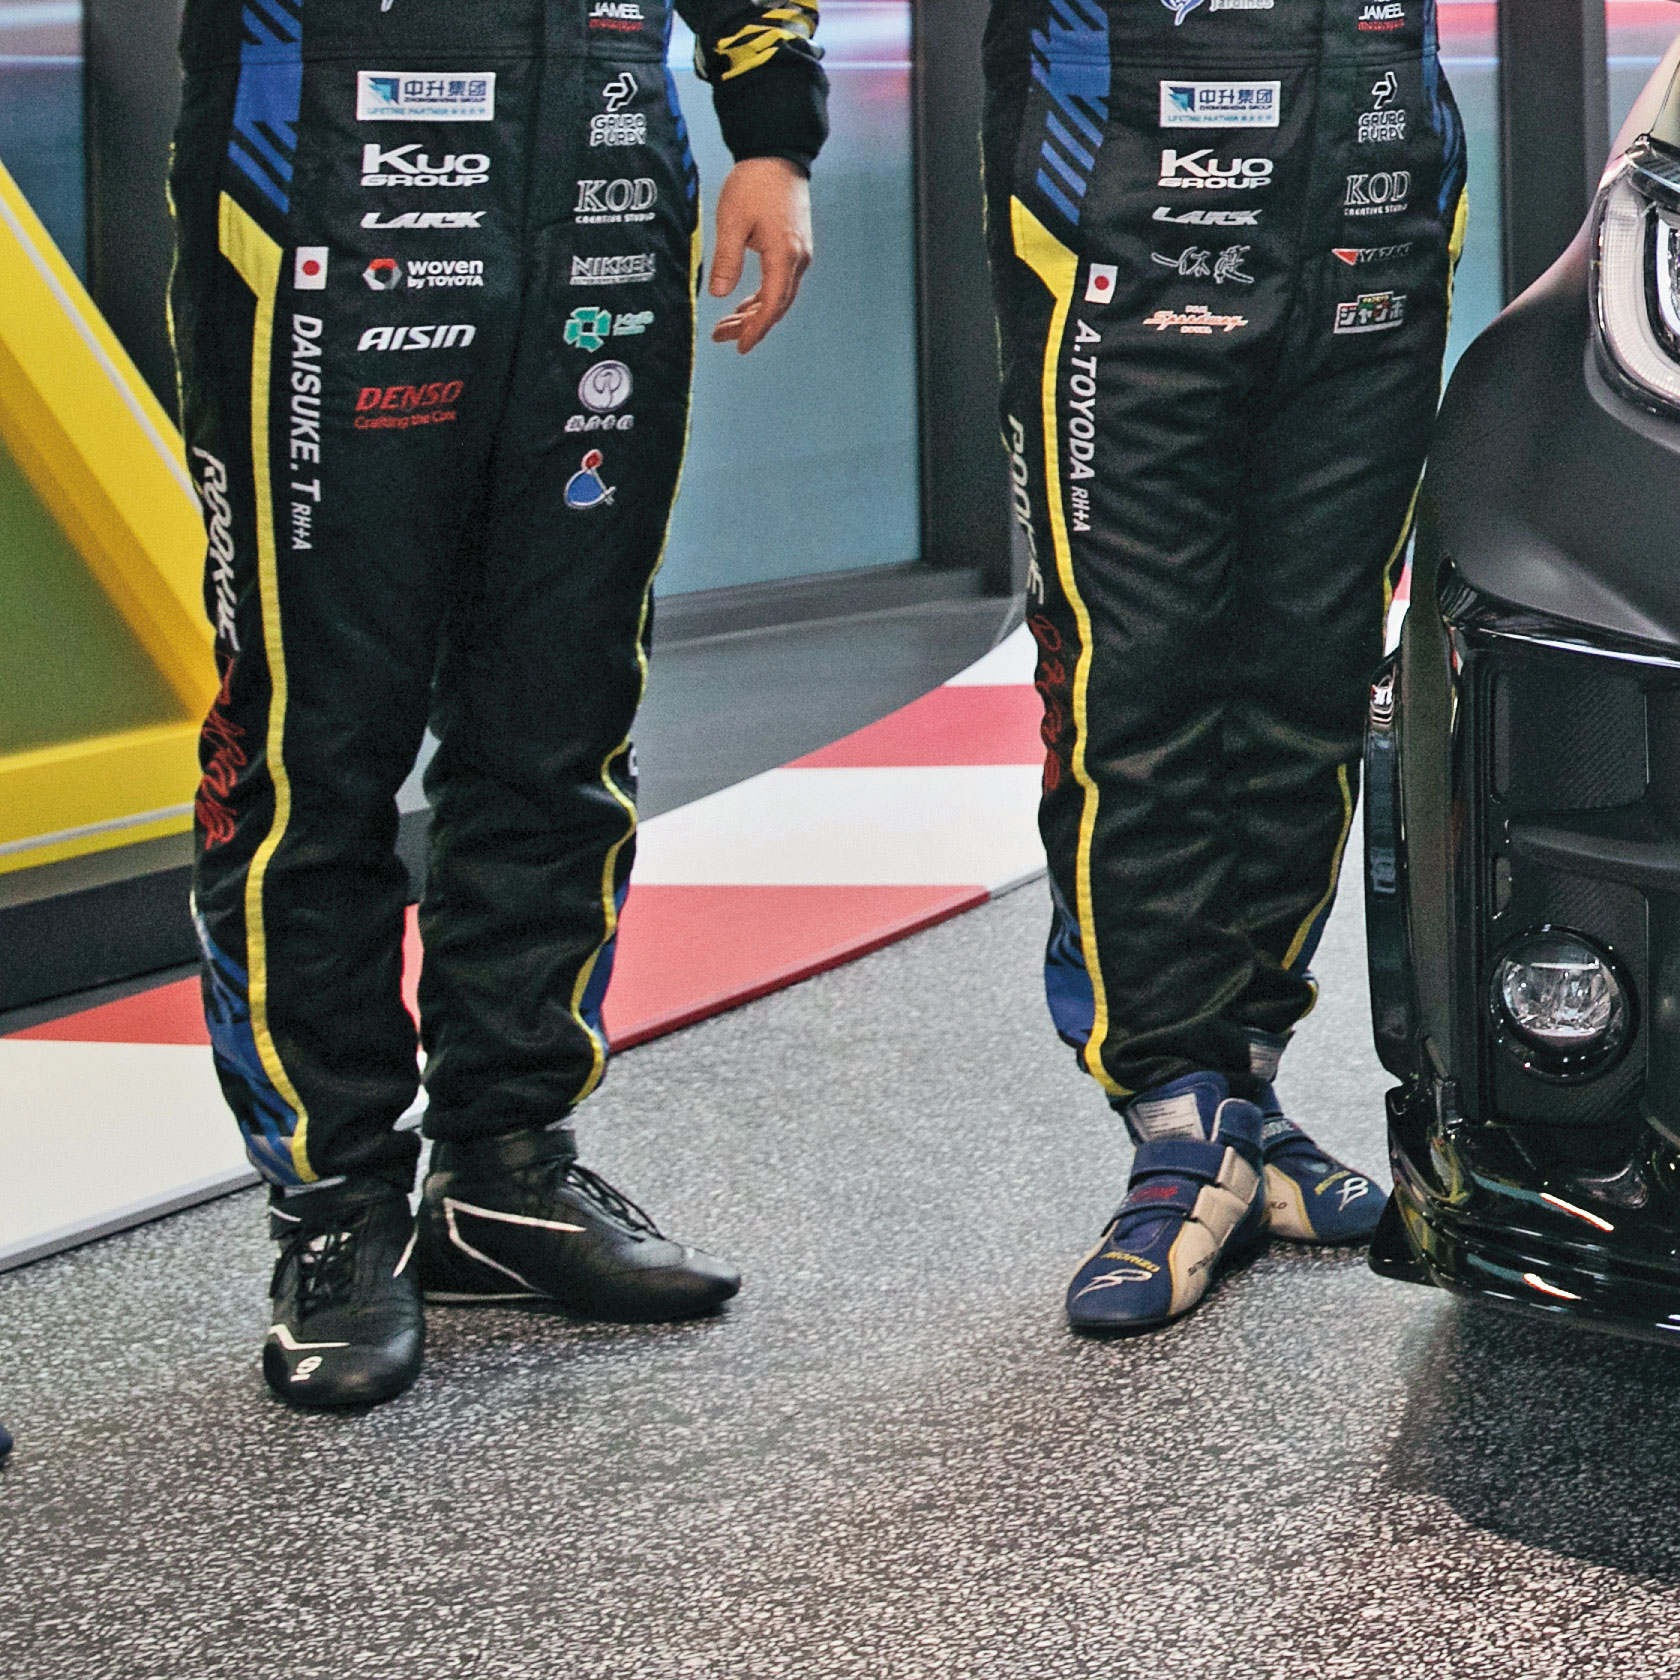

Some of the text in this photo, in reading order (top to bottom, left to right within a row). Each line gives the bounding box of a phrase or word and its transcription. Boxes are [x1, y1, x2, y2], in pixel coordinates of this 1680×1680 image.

[1358, 2, 1406, 21] JAMEEL
[360, 174, 490, 187] GROUP
[1157, 177, 1272, 190] GROUP
[1343, 169, 1412, 206] KOD
[573, 177, 658, 212] KOD
[571, 252, 657, 277] NIKKEN
[406, 275, 484, 290] by TOYOTA
[356, 324, 477, 352] AISIN
[354, 380, 465, 412] DENSO
[1068, 318, 1102, 533] A.TOYODA RH+A
[290, 478, 322, 503] T
[290, 501, 314, 551] RH+A
